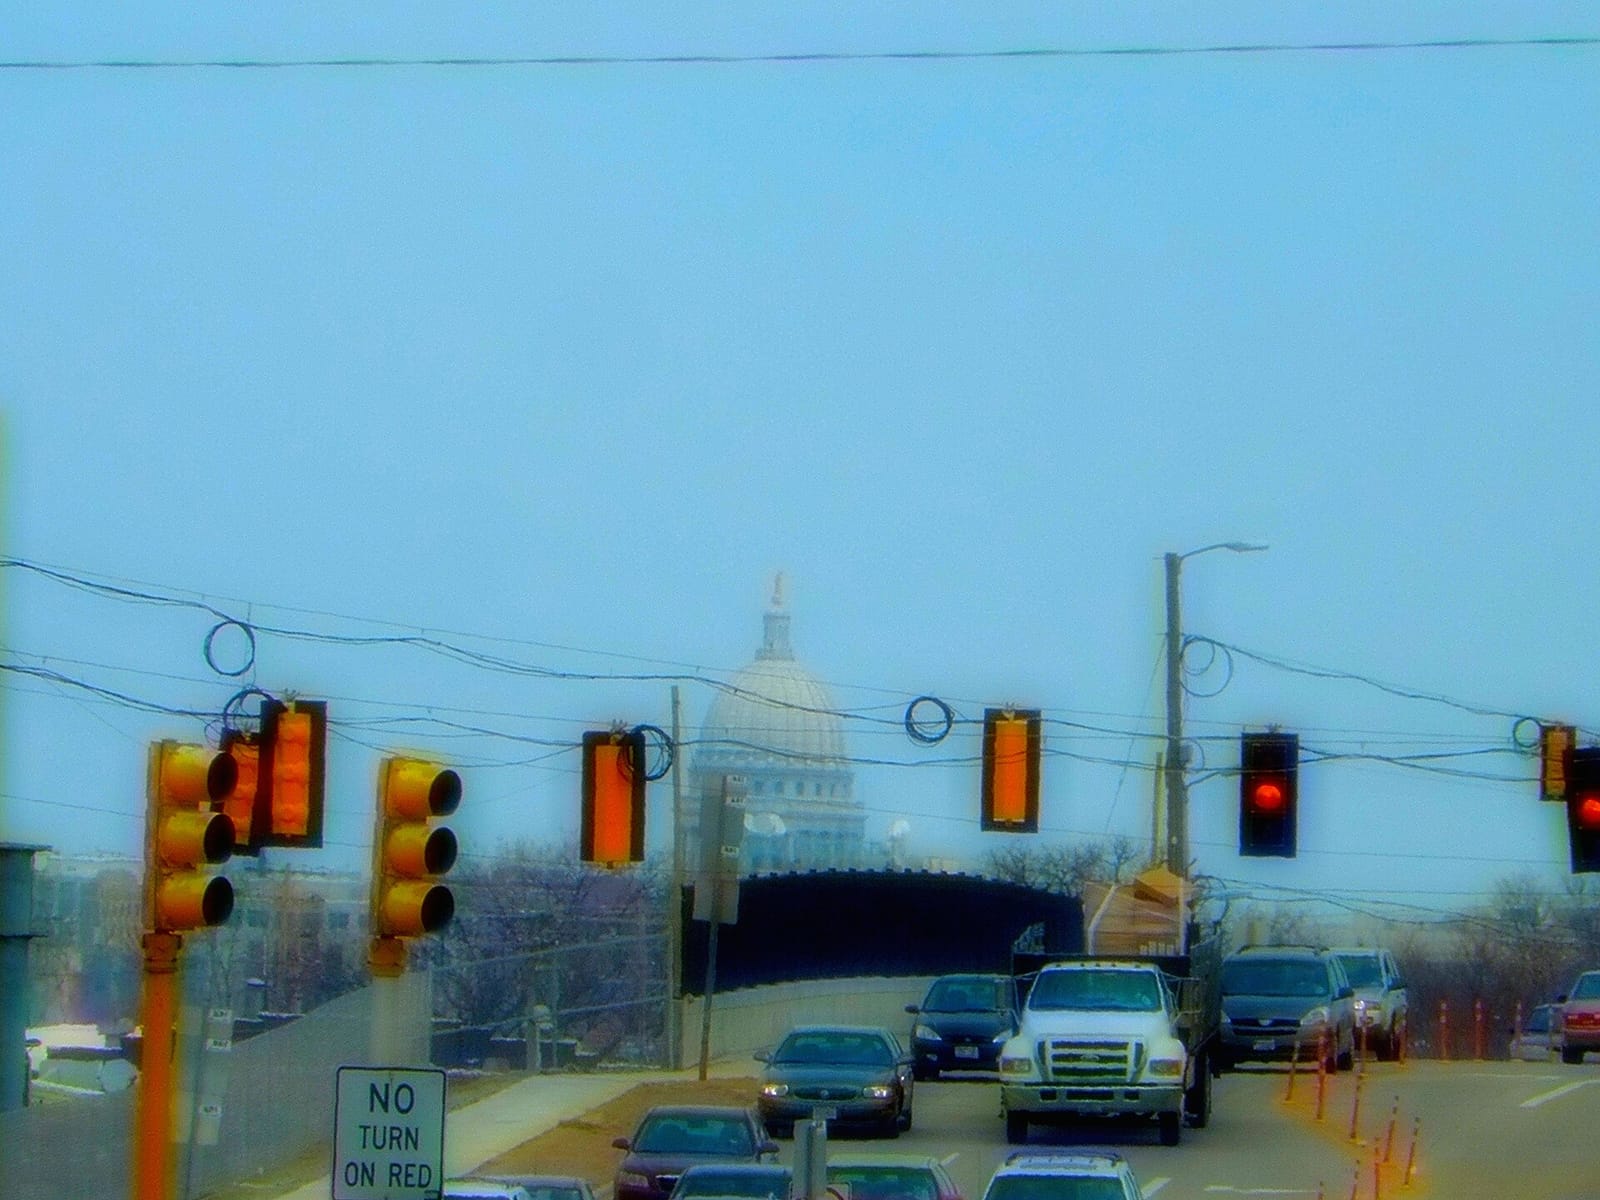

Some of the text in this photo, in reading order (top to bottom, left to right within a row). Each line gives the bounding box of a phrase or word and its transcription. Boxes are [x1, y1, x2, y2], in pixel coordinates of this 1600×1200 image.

[369, 1082, 415, 1115] NO
[358, 1124, 419, 1151] TURN
[344, 1161, 432, 1188] ON RED
